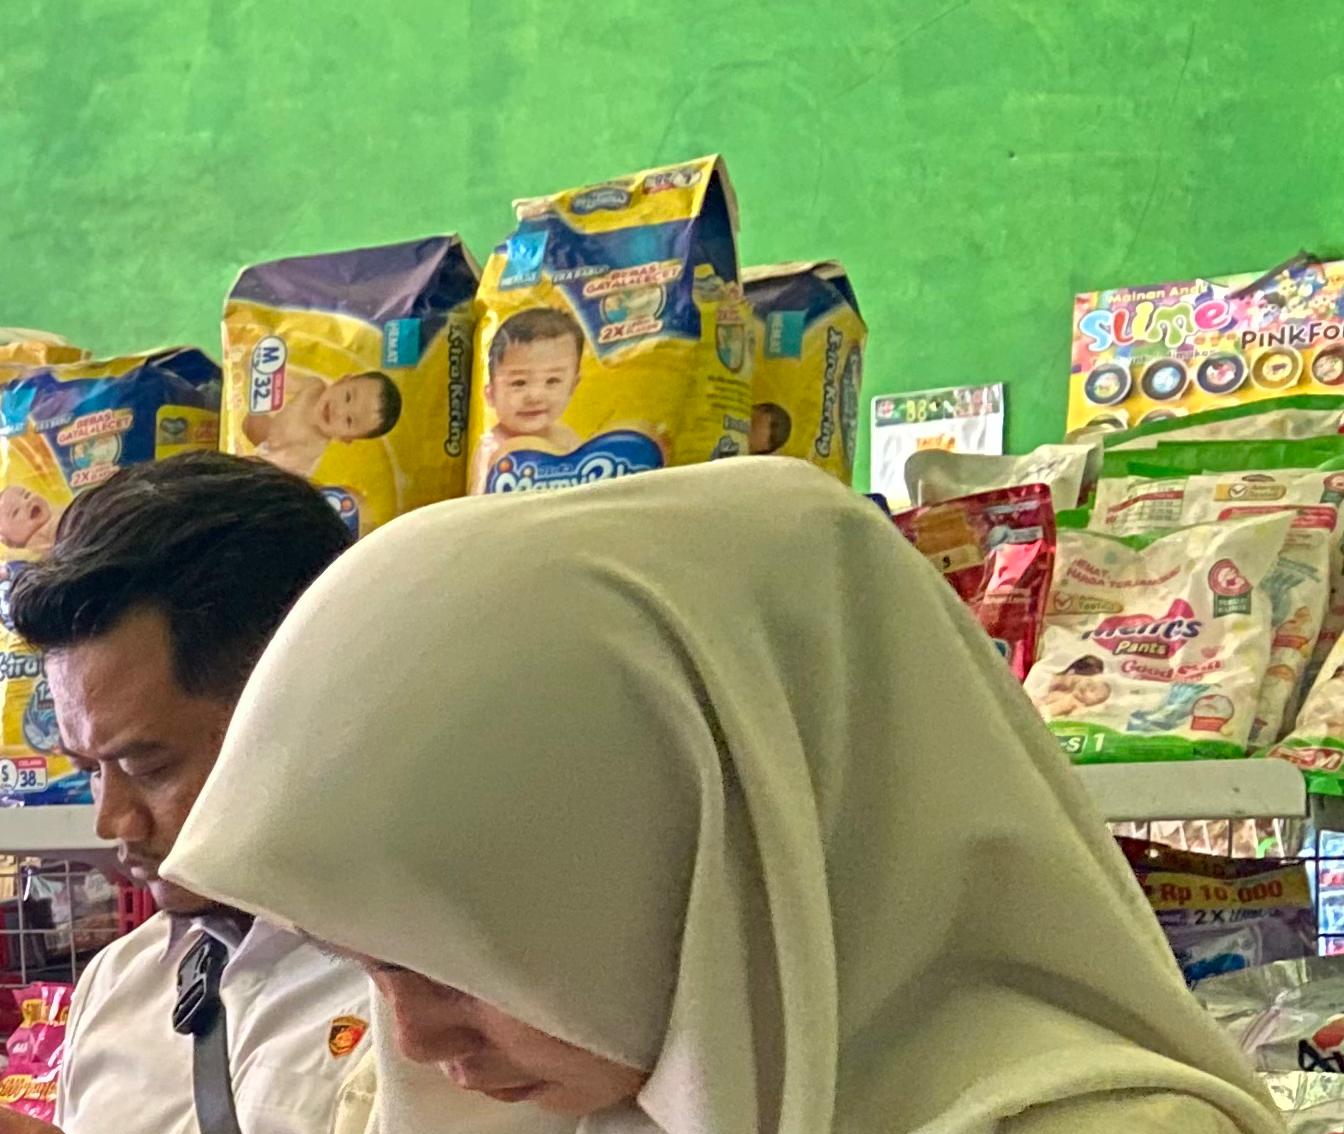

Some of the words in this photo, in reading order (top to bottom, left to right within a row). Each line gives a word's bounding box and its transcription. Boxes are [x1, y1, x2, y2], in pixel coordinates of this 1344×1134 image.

[1241, 322, 1344, 350] PINKFO
[262, 346, 280, 364] M
[253, 376, 272, 402] 32
[19, 769, 38, 788] 38
